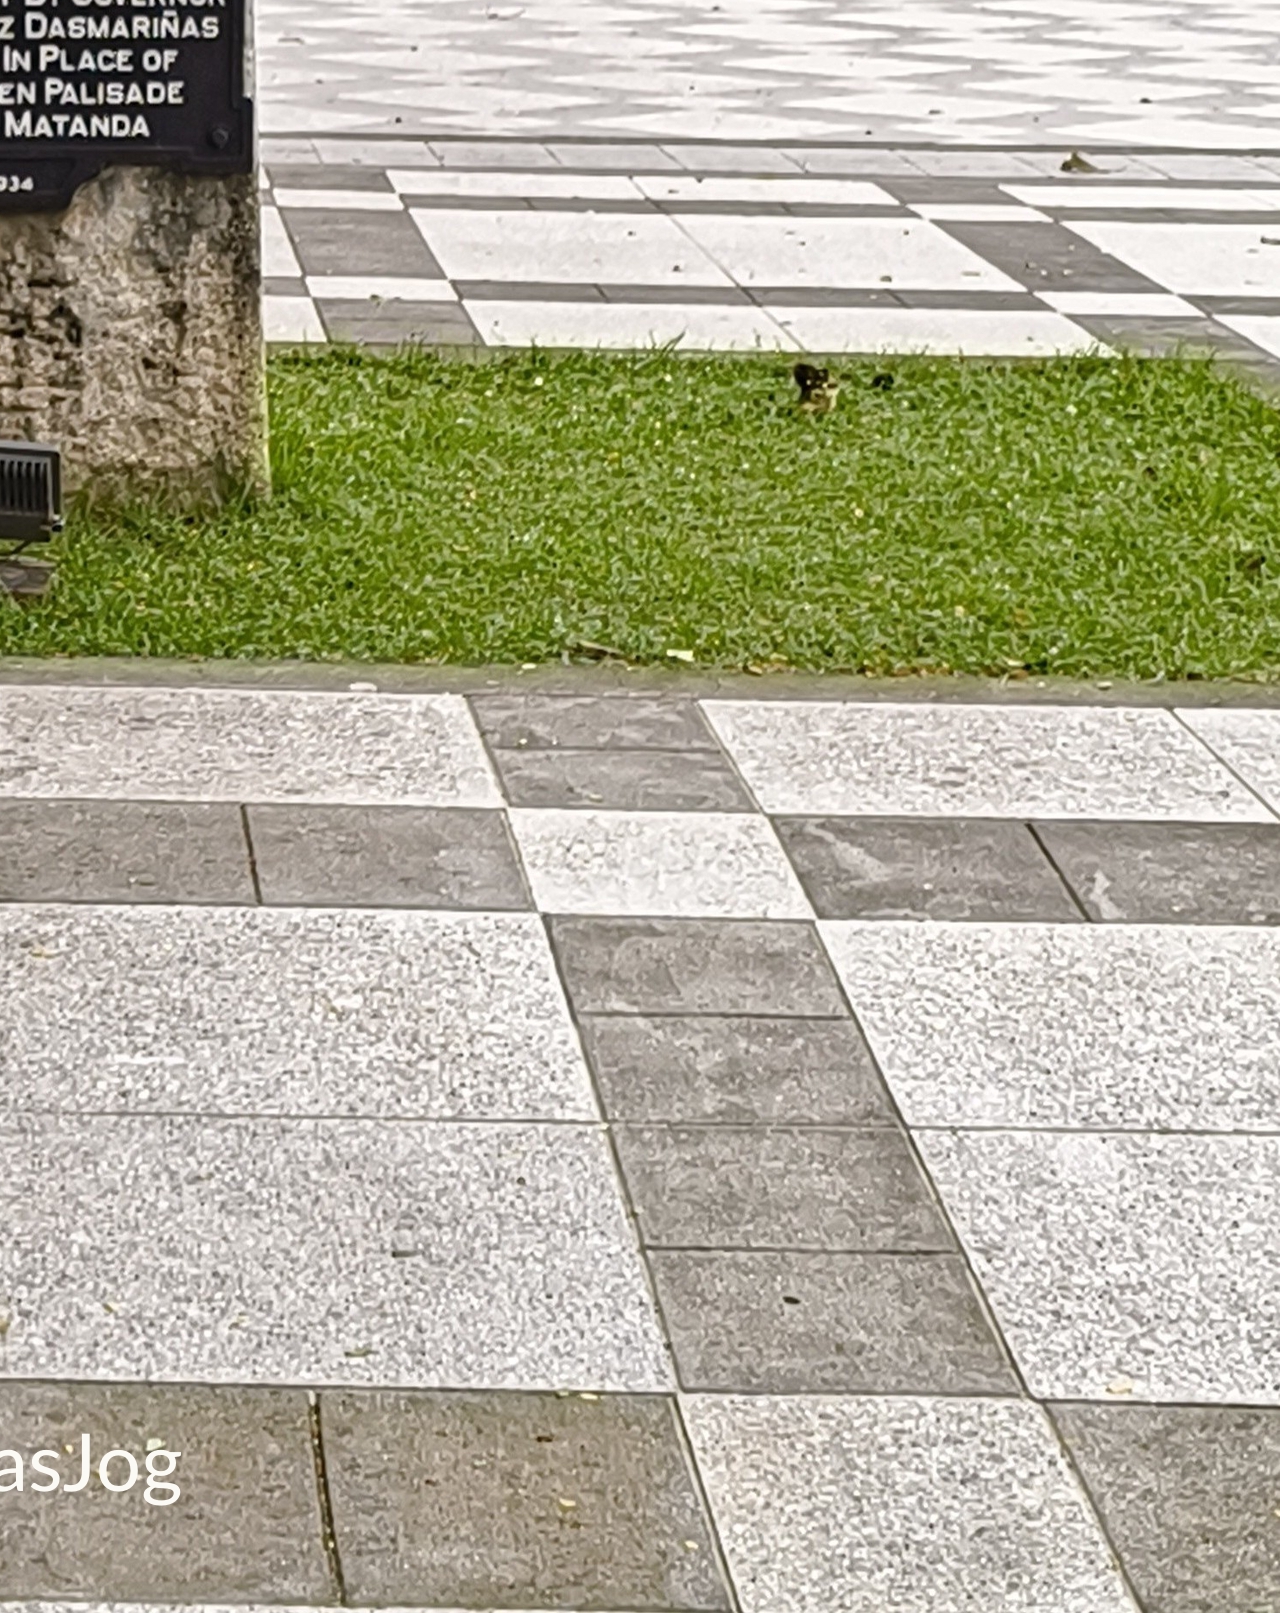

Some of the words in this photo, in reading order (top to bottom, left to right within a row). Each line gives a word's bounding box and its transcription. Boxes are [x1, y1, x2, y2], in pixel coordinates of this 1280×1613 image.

[24, 8, 220, 40] DASMARIÑAS
[2, 47, 31, 73] IN
[38, 47, 134, 73] PLACE
[141, 47, 179, 73] OF
[43, 78, 185, 106] PALISADE
[3, 110, 151, 139] MATANDA
